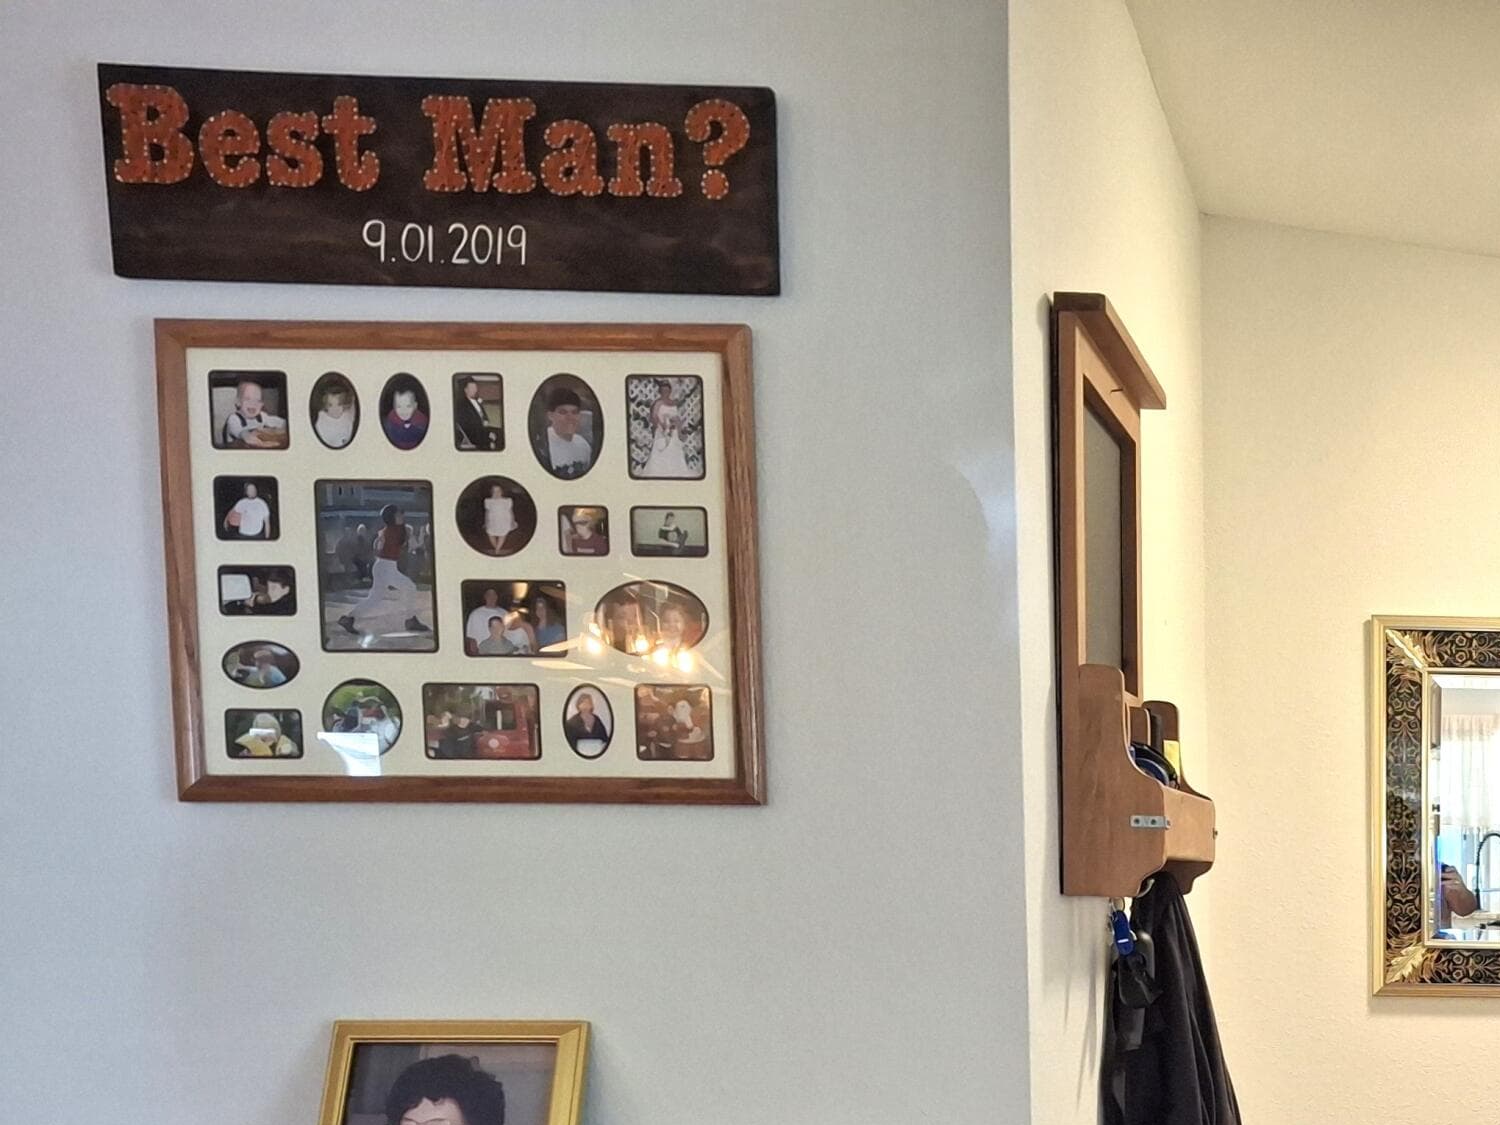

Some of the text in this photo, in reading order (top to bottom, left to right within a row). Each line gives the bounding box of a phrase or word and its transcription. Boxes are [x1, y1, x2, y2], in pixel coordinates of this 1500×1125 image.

[106, 84, 751, 200] Best Man?
[362, 219, 527, 265] 9.01.2019
